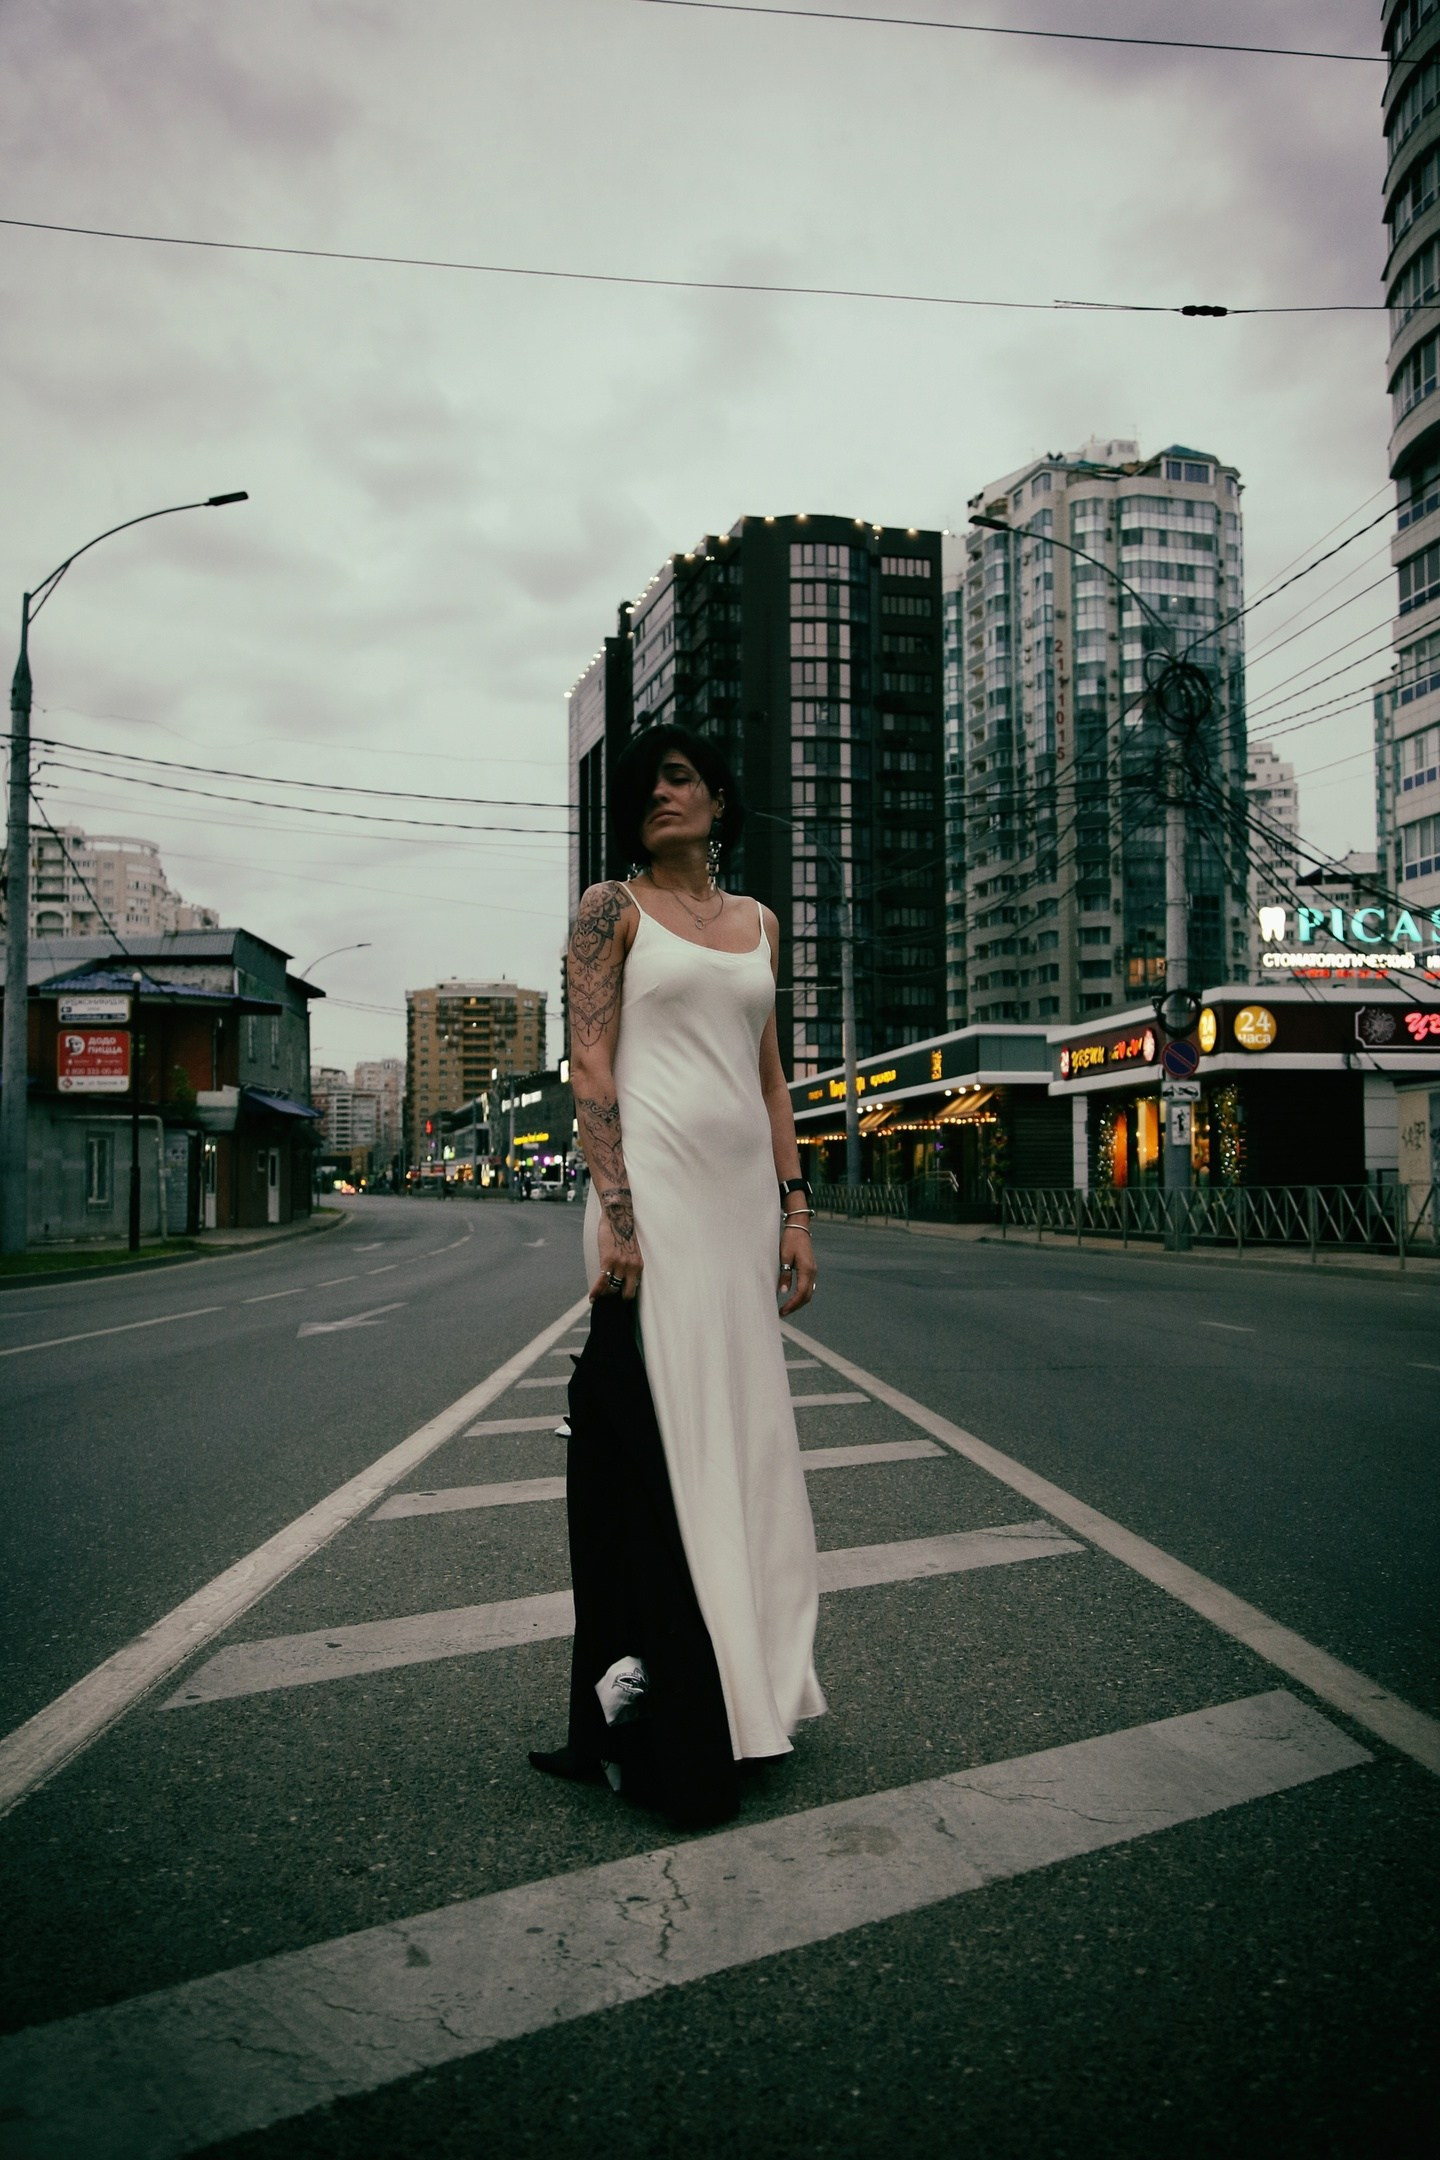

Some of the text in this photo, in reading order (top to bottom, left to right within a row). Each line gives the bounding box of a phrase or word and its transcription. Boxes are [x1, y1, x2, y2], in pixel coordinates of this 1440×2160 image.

[1240, 1011, 1271, 1032] 24
[1237, 1033, 1271, 1044] часа
[88, 1046, 123, 1054] ПИЦЦА
